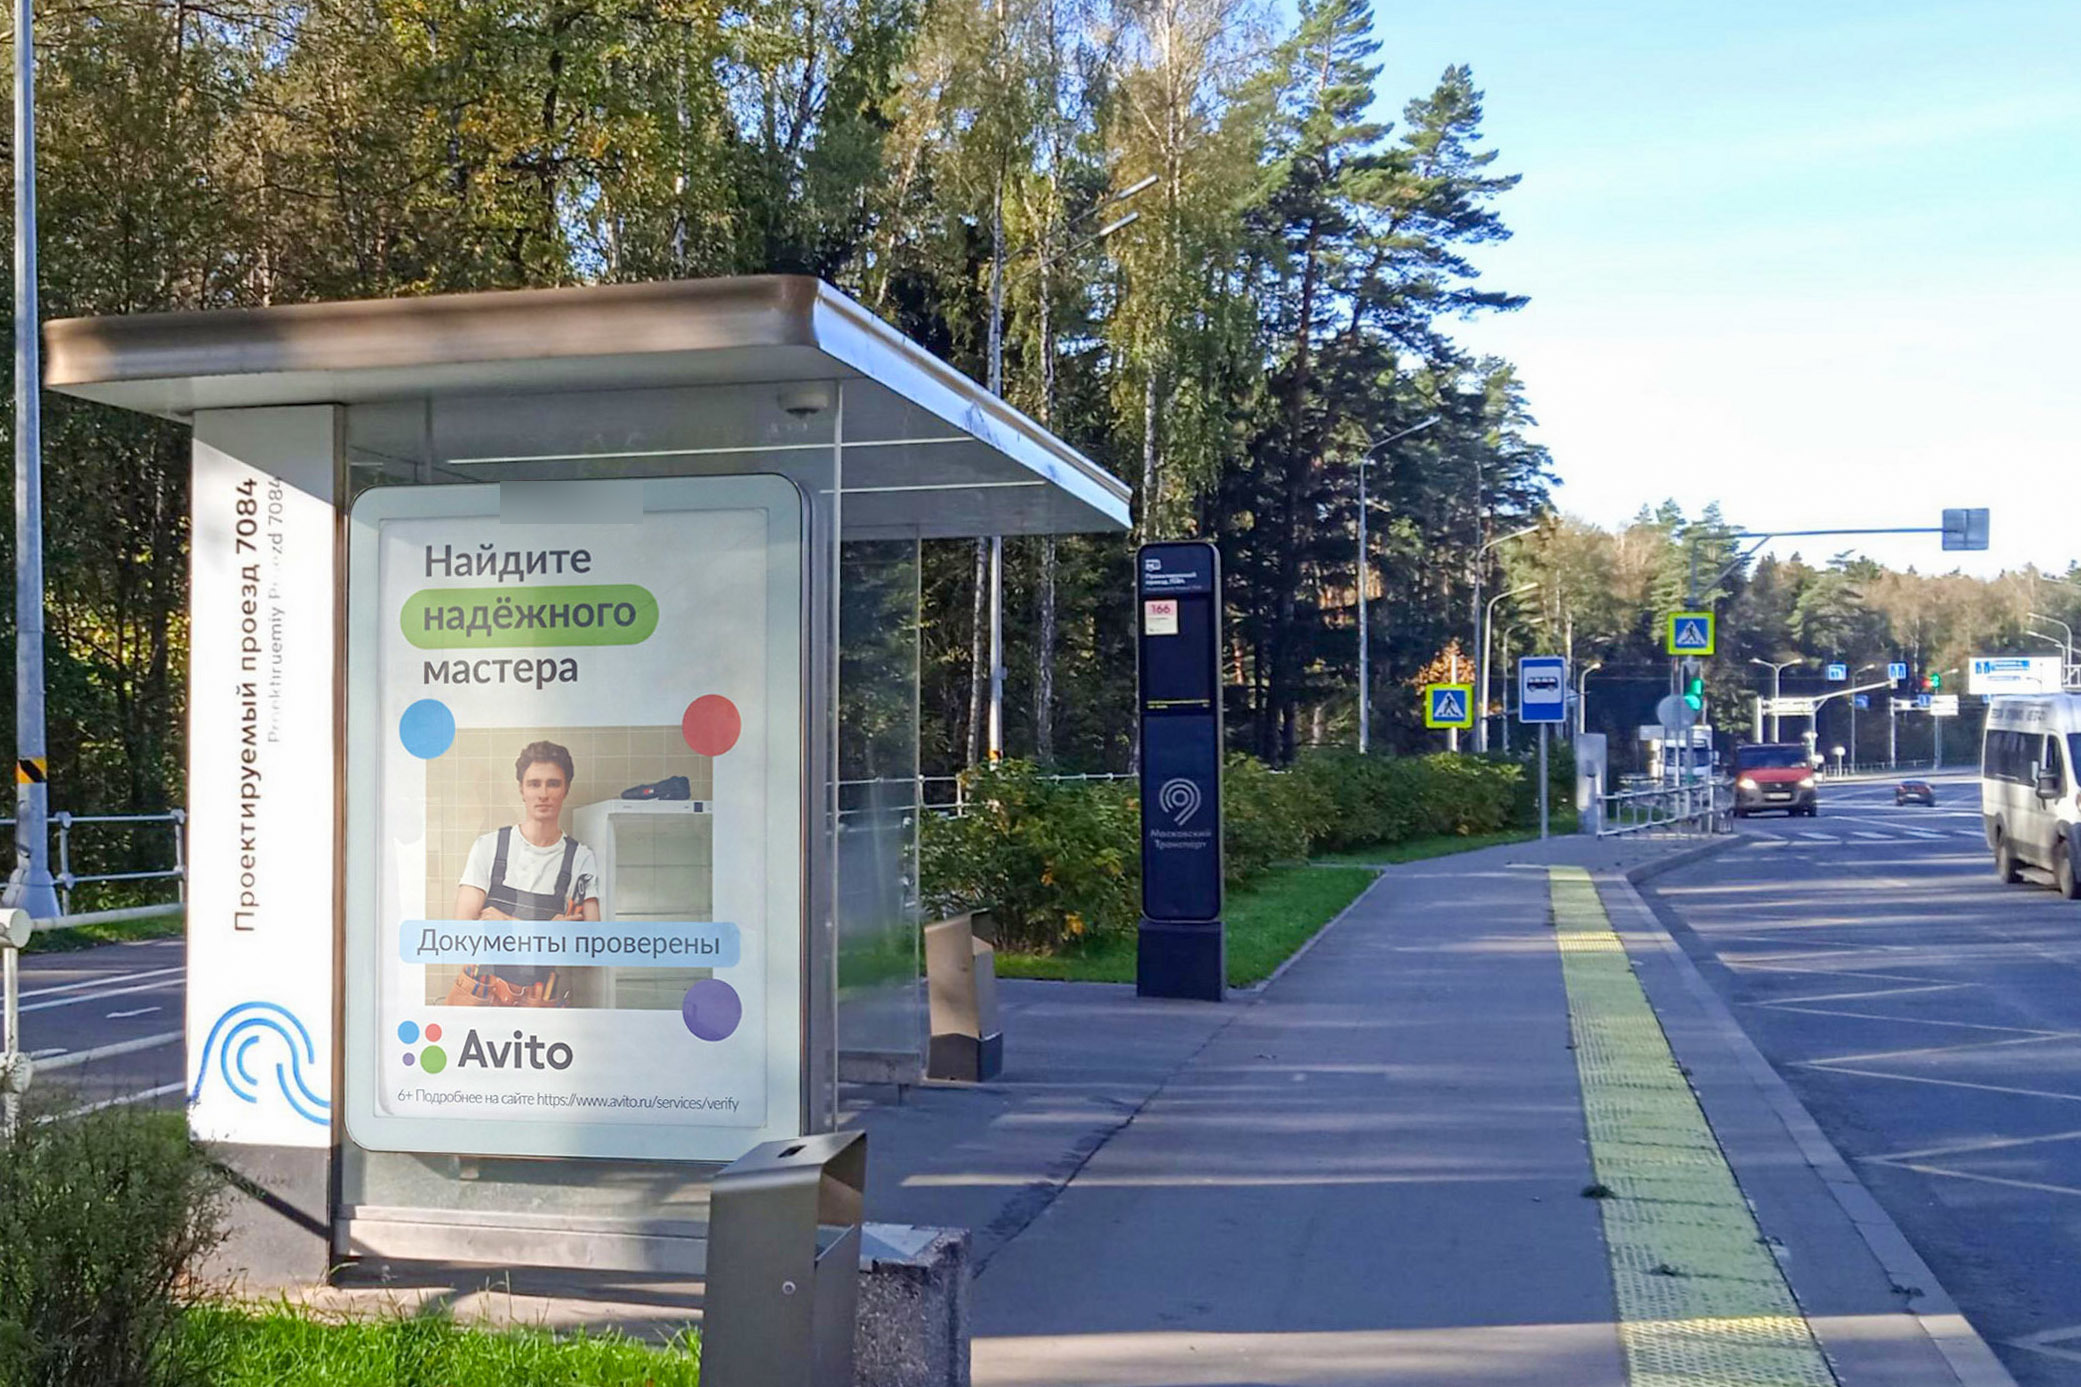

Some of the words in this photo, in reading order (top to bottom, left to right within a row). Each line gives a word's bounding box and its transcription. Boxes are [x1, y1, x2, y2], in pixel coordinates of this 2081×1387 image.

[236, 478, 258, 554] 7084
[268, 476, 283, 525] 7084
[425, 543, 592, 583] Найдите
[241, 564, 262, 671] проезд
[424, 596, 637, 638] надёжного
[1152, 604, 1171, 614] 166
[423, 657, 578, 690] мастера
[234, 682, 262, 931] Проектируемый
[417, 929, 566, 957] Документы
[575, 933, 720, 959] проверены
[457, 1029, 573, 1070] Avito
[397, 1089, 413, 1102] 6+
[415, 1088, 482, 1104] Подробнее
[485, 1094, 499, 1104] на
[501, 1092, 535, 1105] сайте
[536, 1092, 739, 1112] https://www.avito.ru/services/verify
